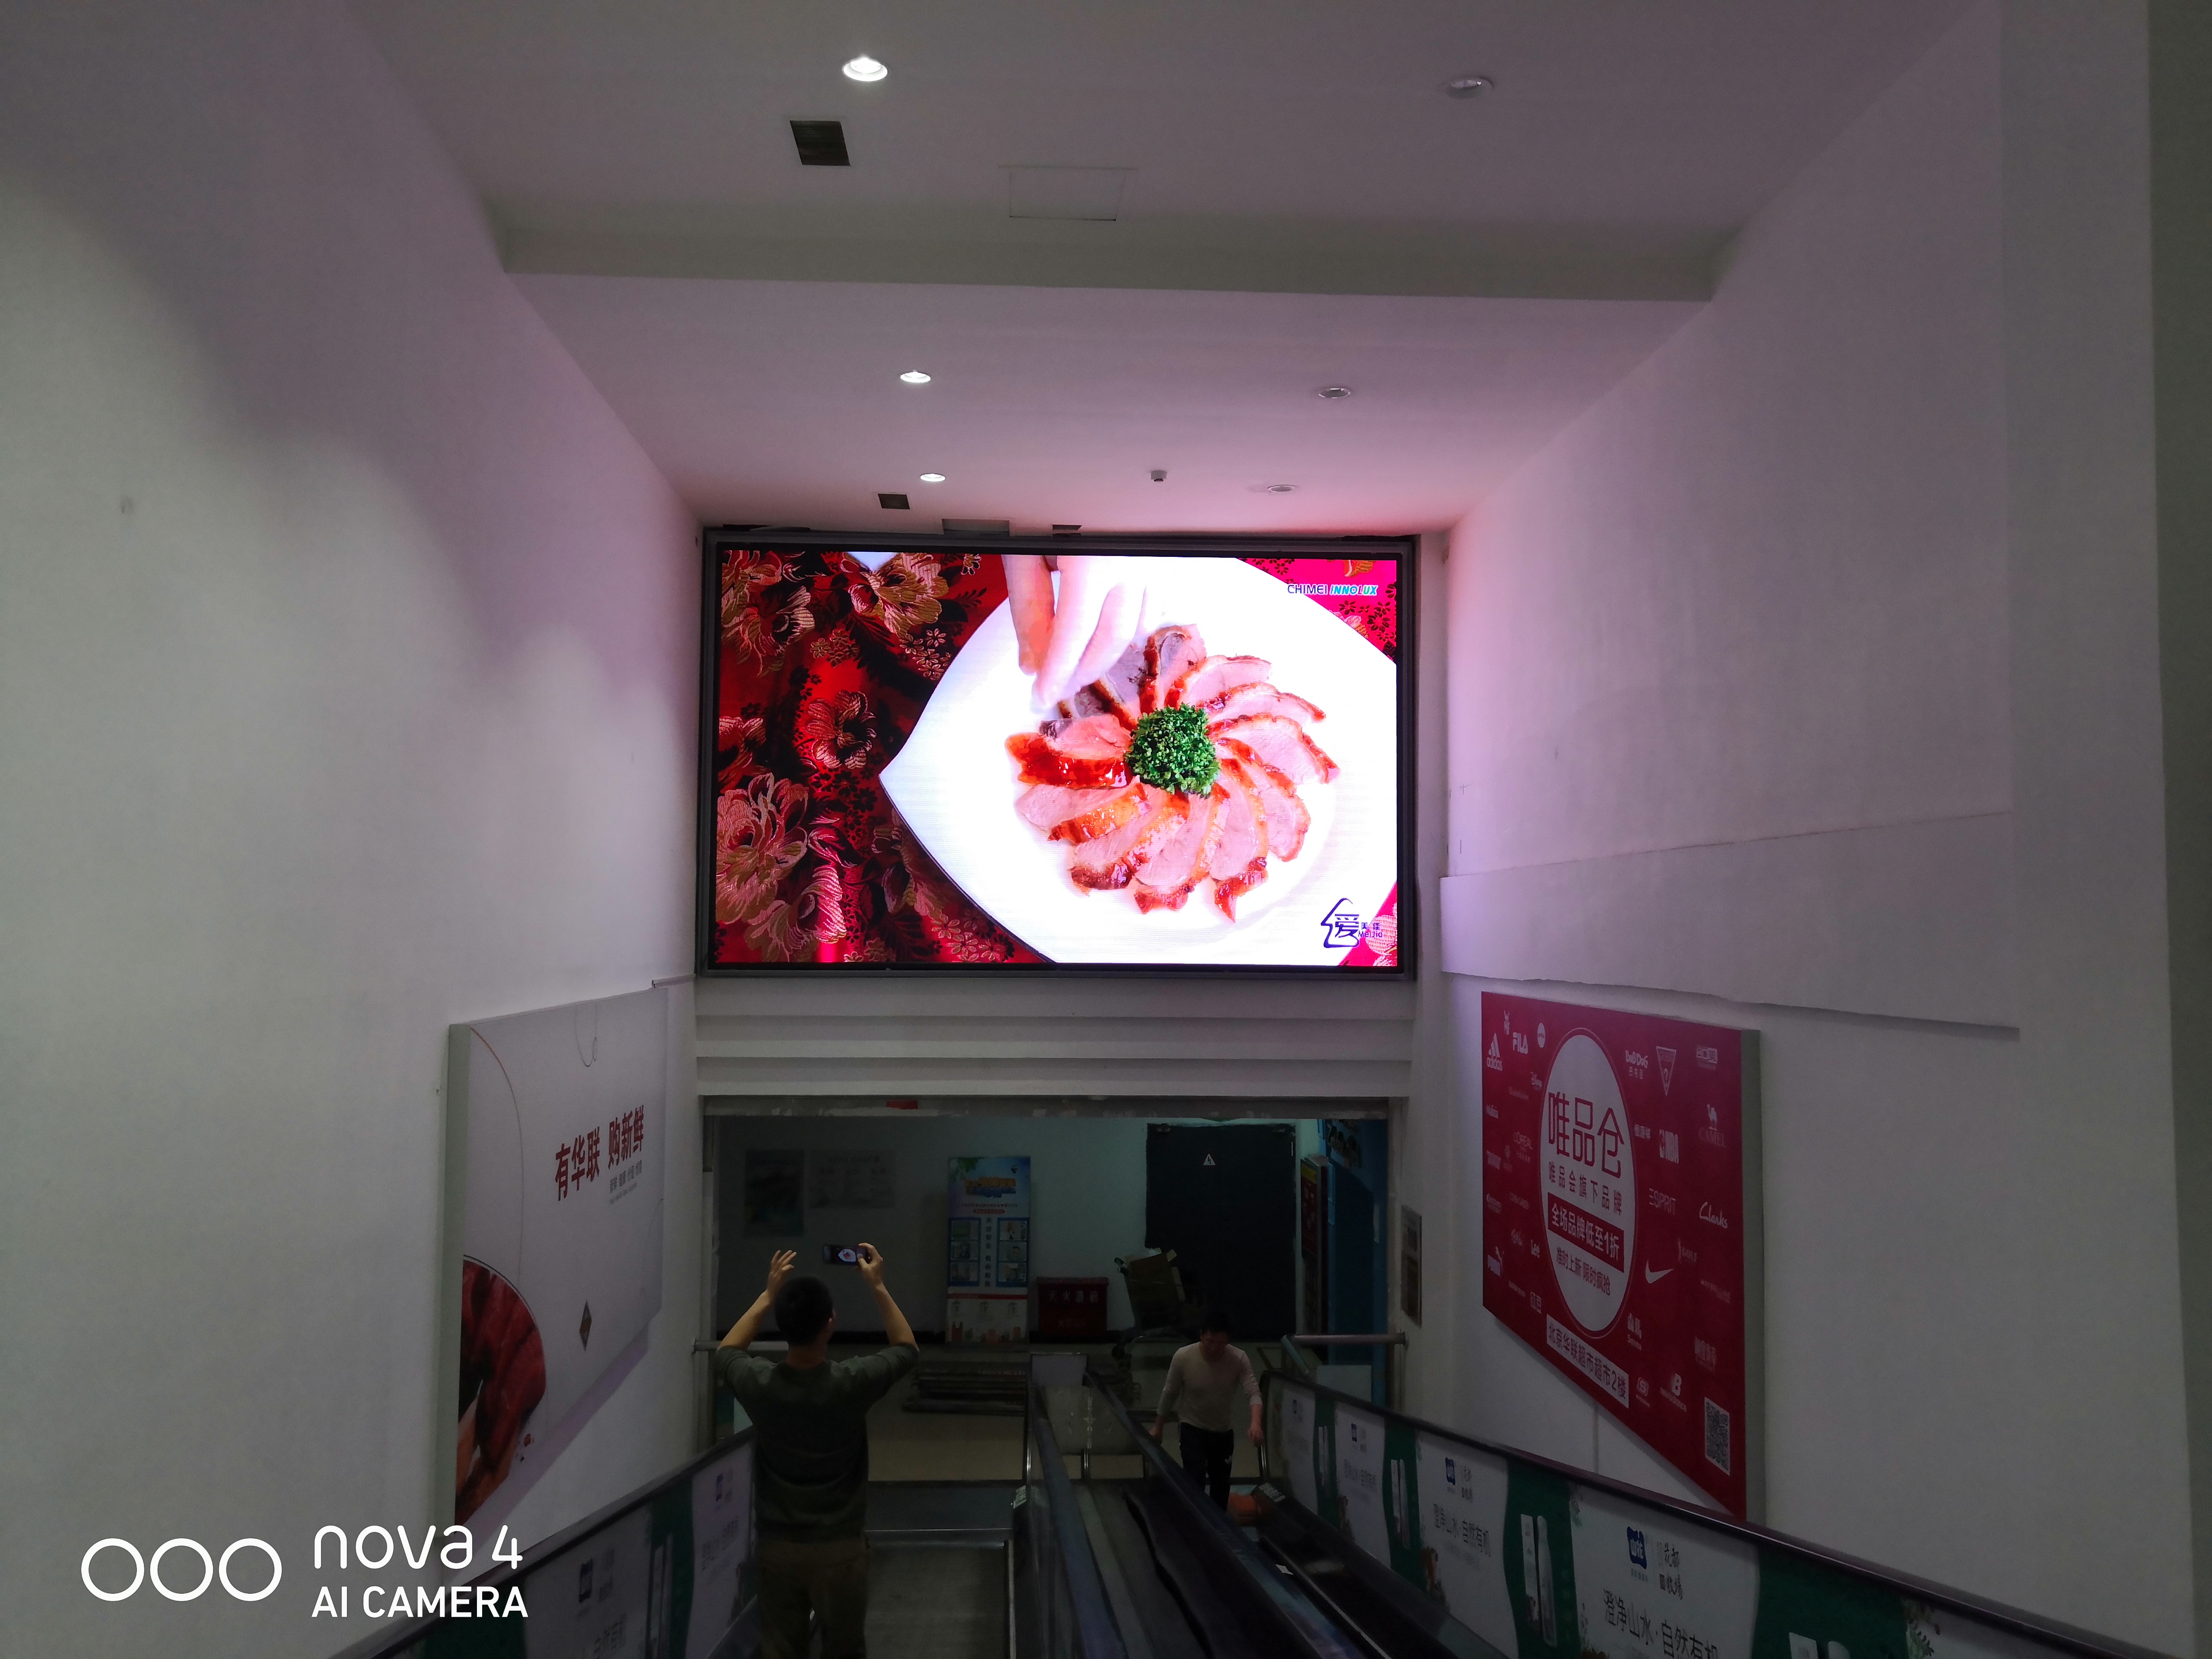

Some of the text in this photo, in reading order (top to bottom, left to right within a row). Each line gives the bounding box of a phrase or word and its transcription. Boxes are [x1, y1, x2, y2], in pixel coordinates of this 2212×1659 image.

[1287, 585, 1377, 595] CHIMEI INNOLUX
[1513, 1032, 1529, 1055] FILA
[555, 1126, 600, 1201] 有华联
[608, 1104, 644, 1170] 购新鲜
[1548, 1091, 1624, 1179] 唯品仓
[1549, 1161, 1622, 1216] 唯品会旗下品牌
[1649, 1188, 1676, 1215] ESPRIT
[1699, 1201, 1728, 1229] Clarks
[1551, 1203, 1620, 1261] 全场品牌低至1折
[1548, 1322, 1626, 1400] 北京华联超市超市2楼
